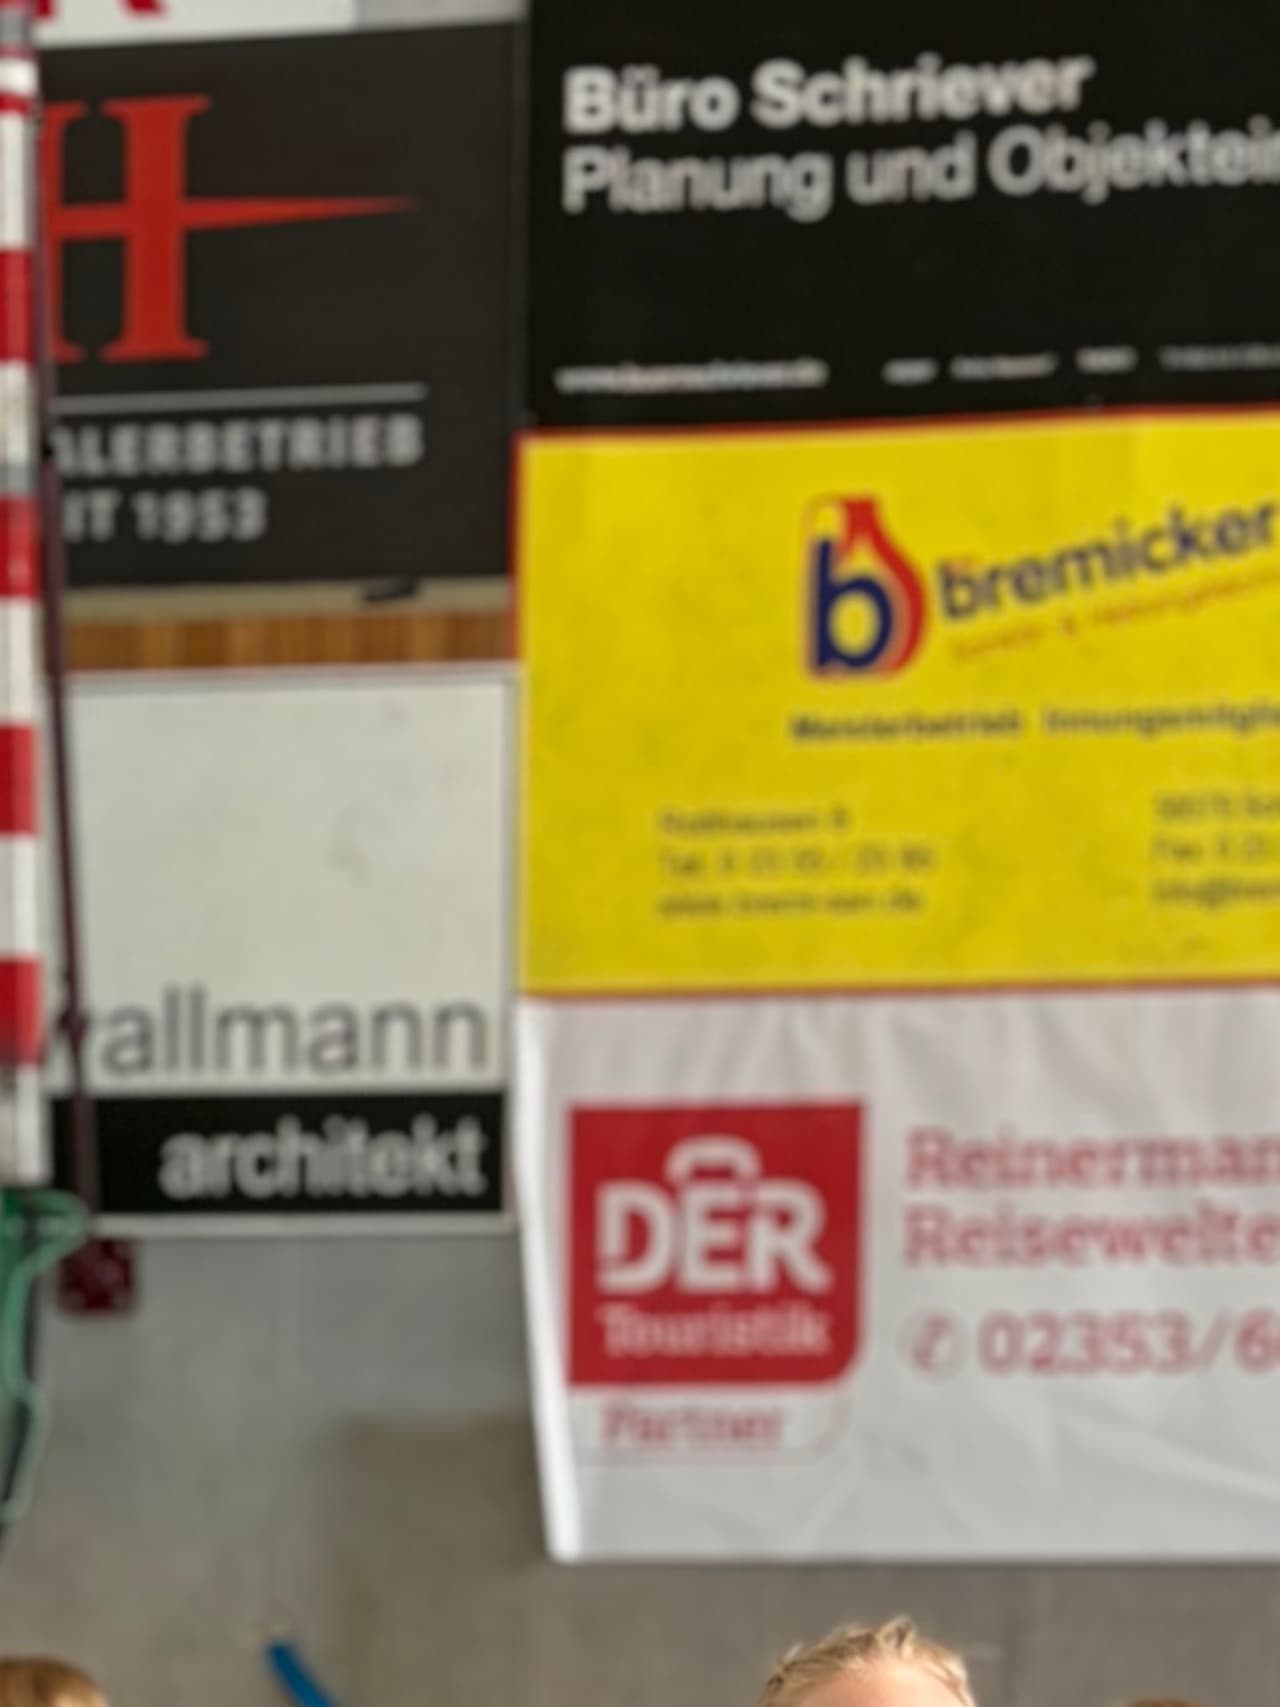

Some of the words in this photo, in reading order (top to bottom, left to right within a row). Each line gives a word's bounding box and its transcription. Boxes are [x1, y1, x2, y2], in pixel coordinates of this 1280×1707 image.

[563, 65, 739, 134] Büro
[751, 52, 1093, 128] Schriever
[563, 146, 832, 221] Planung
[848, 134, 975, 200] und
[133, 489, 267, 543] 1953
[90, 984, 489, 1075] allmann
[157, 1113, 491, 1199] architekt
[596, 1182, 834, 1295] DER
[596, 1301, 834, 1358] Touristik
[600, 1404, 785, 1451] Partner
